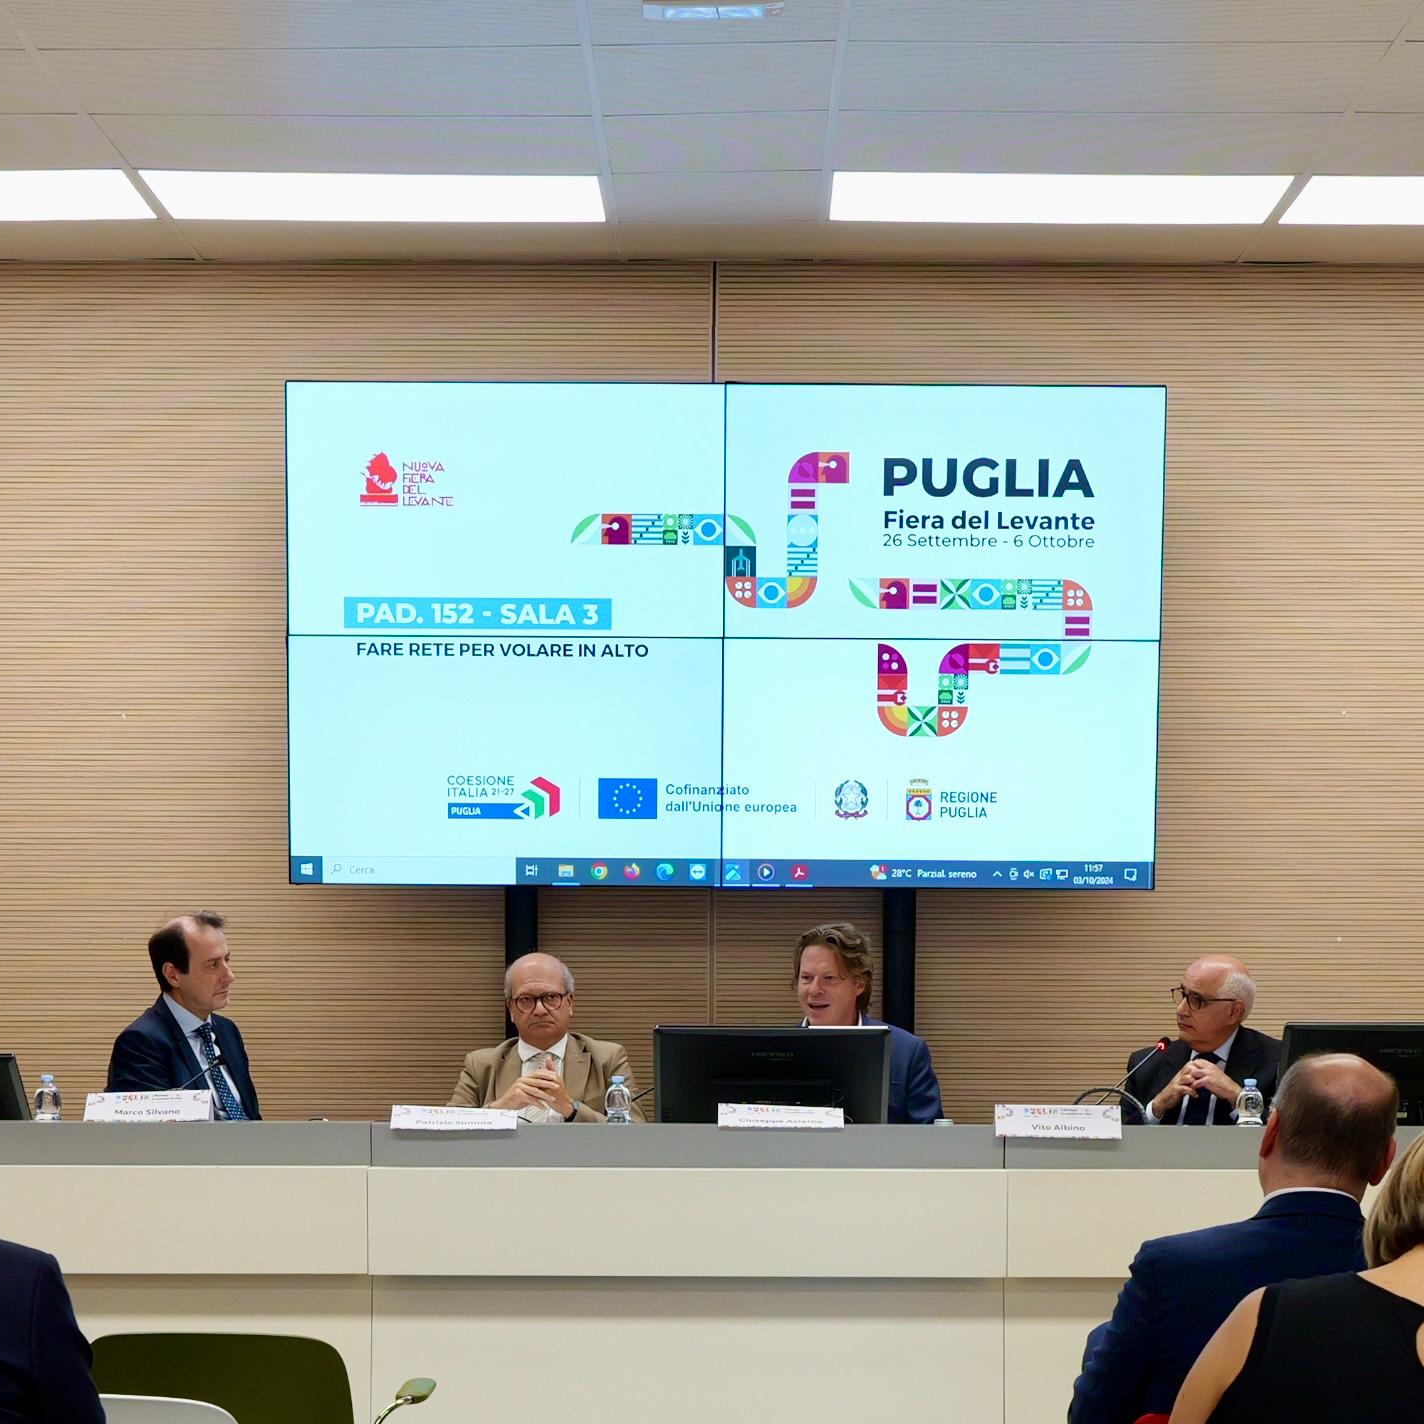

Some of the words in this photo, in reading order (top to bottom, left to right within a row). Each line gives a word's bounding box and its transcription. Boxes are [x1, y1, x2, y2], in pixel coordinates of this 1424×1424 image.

[402, 461, 445, 472] NUOVA
[883, 457, 1095, 498] PUGLIA
[402, 484, 427, 494] DEL
[402, 496, 454, 506] LEVANTE
[884, 509, 944, 530] Fiera
[951, 510, 989, 530] del
[997, 511, 1095, 530] Levante
[882, 533, 902, 547] 26
[907, 533, 998, 548] Settembre
[1013, 534, 1024, 548] 6
[1028, 534, 1095, 548] Ottobre
[356, 602, 424, 624] PAD.
[430, 603, 474, 625] 152
[500, 603, 576, 625] SALA
[582, 604, 599, 625] 3
[356, 642, 404, 656] FARE
[409, 642, 455, 657] RETE
[460, 643, 495, 657] PER
[499, 643, 574, 657] VOLARE
[578, 644, 596, 658] IN
[600, 644, 649, 658] ALTO
[447, 775, 515, 786] COESIONE
[447, 787, 488, 797] ITALIA
[491, 787, 514, 796] 21-27
[665, 783, 750, 795] Cofinanziato
[939, 791, 998, 803] REGIONE
[450, 806, 482, 816] PUGLIA
[665, 801, 740, 813] dall'Unione
[744, 803, 797, 815] europea
[939, 806, 988, 819] PUGLIA
[349, 865, 375, 875] Cerca
[891, 868, 912, 878] 28°C
[947, 870, 978, 879] sereno
[1084, 864, 1104, 873] 11:57
[1072, 876, 1114, 885] 03/10/2024
